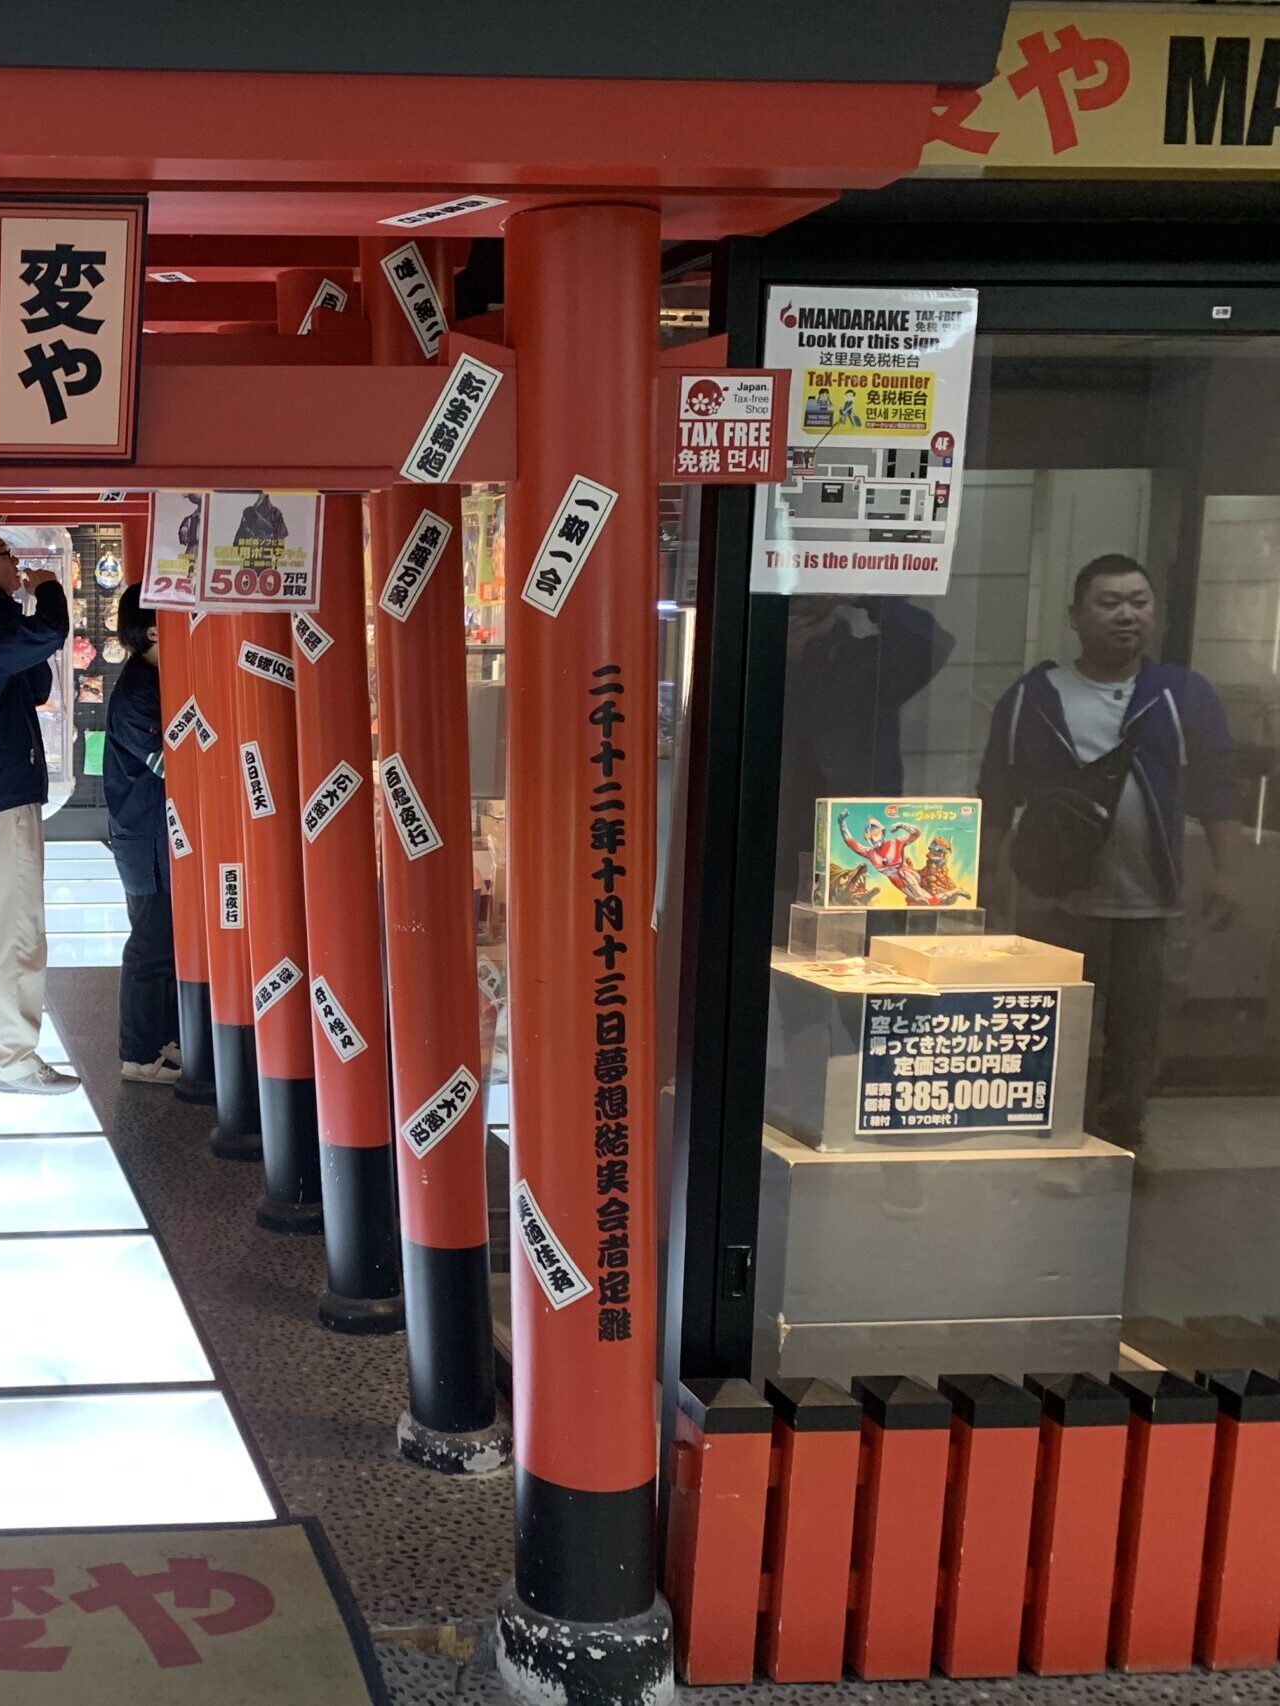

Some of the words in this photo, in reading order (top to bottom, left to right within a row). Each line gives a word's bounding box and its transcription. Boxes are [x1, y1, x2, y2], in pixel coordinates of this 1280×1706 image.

[799, 308, 910, 331] MANDARAKE
[17, 243, 106, 425] 変や
[798, 332, 836, 348] Look
[841, 333, 864, 349] for
[868, 334, 899, 350] this
[820, 351, 920, 368] 这里是免税柜台
[872, 373, 930, 389] Counter
[733, 394, 769, 403] Tax-free
[867, 390, 927, 406] 免税柜台
[745, 405, 769, 415] Shop
[866, 408, 888, 420] 면세
[892, 408, 926, 421] 카운터
[680, 422, 718, 447] TAX
[723, 422, 771, 447] FREE
[935, 437, 949, 451] 4F
[677, 449, 720, 473] 免税
[727, 449, 769, 473] 면세
[535, 499, 600, 596] 一期一会
[387, 524, 442, 609] 森羅万象
[804, 552, 819, 568] is
[822, 552, 848, 569] the
[852, 553, 899, 571] fourth
[903, 556, 939, 572] floor.
[210, 568, 281, 596] 500
[283, 572, 308, 583] 万円
[283, 585, 307, 596] 買取
[243, 751, 268, 810] 白日昇天
[384, 766, 430, 847] 百鬼夜行
[224, 870, 238, 923] 百鬼夜行
[870, 998, 907, 1011] マルイ
[993, 995, 1055, 1009] プラモデル
[870, 1013, 1050, 1034] 空とぶウルトラマン
[870, 1034, 1048, 1056] 帰ってきたウルトラマン
[893, 1054, 1022, 1076] 定価350円版
[865, 1083, 892, 1096] 販売
[895, 1079, 1033, 1113] 385,000円
[864, 1098, 891, 1112] 価格
[515, 1193, 576, 1295] 美酒佳肴
